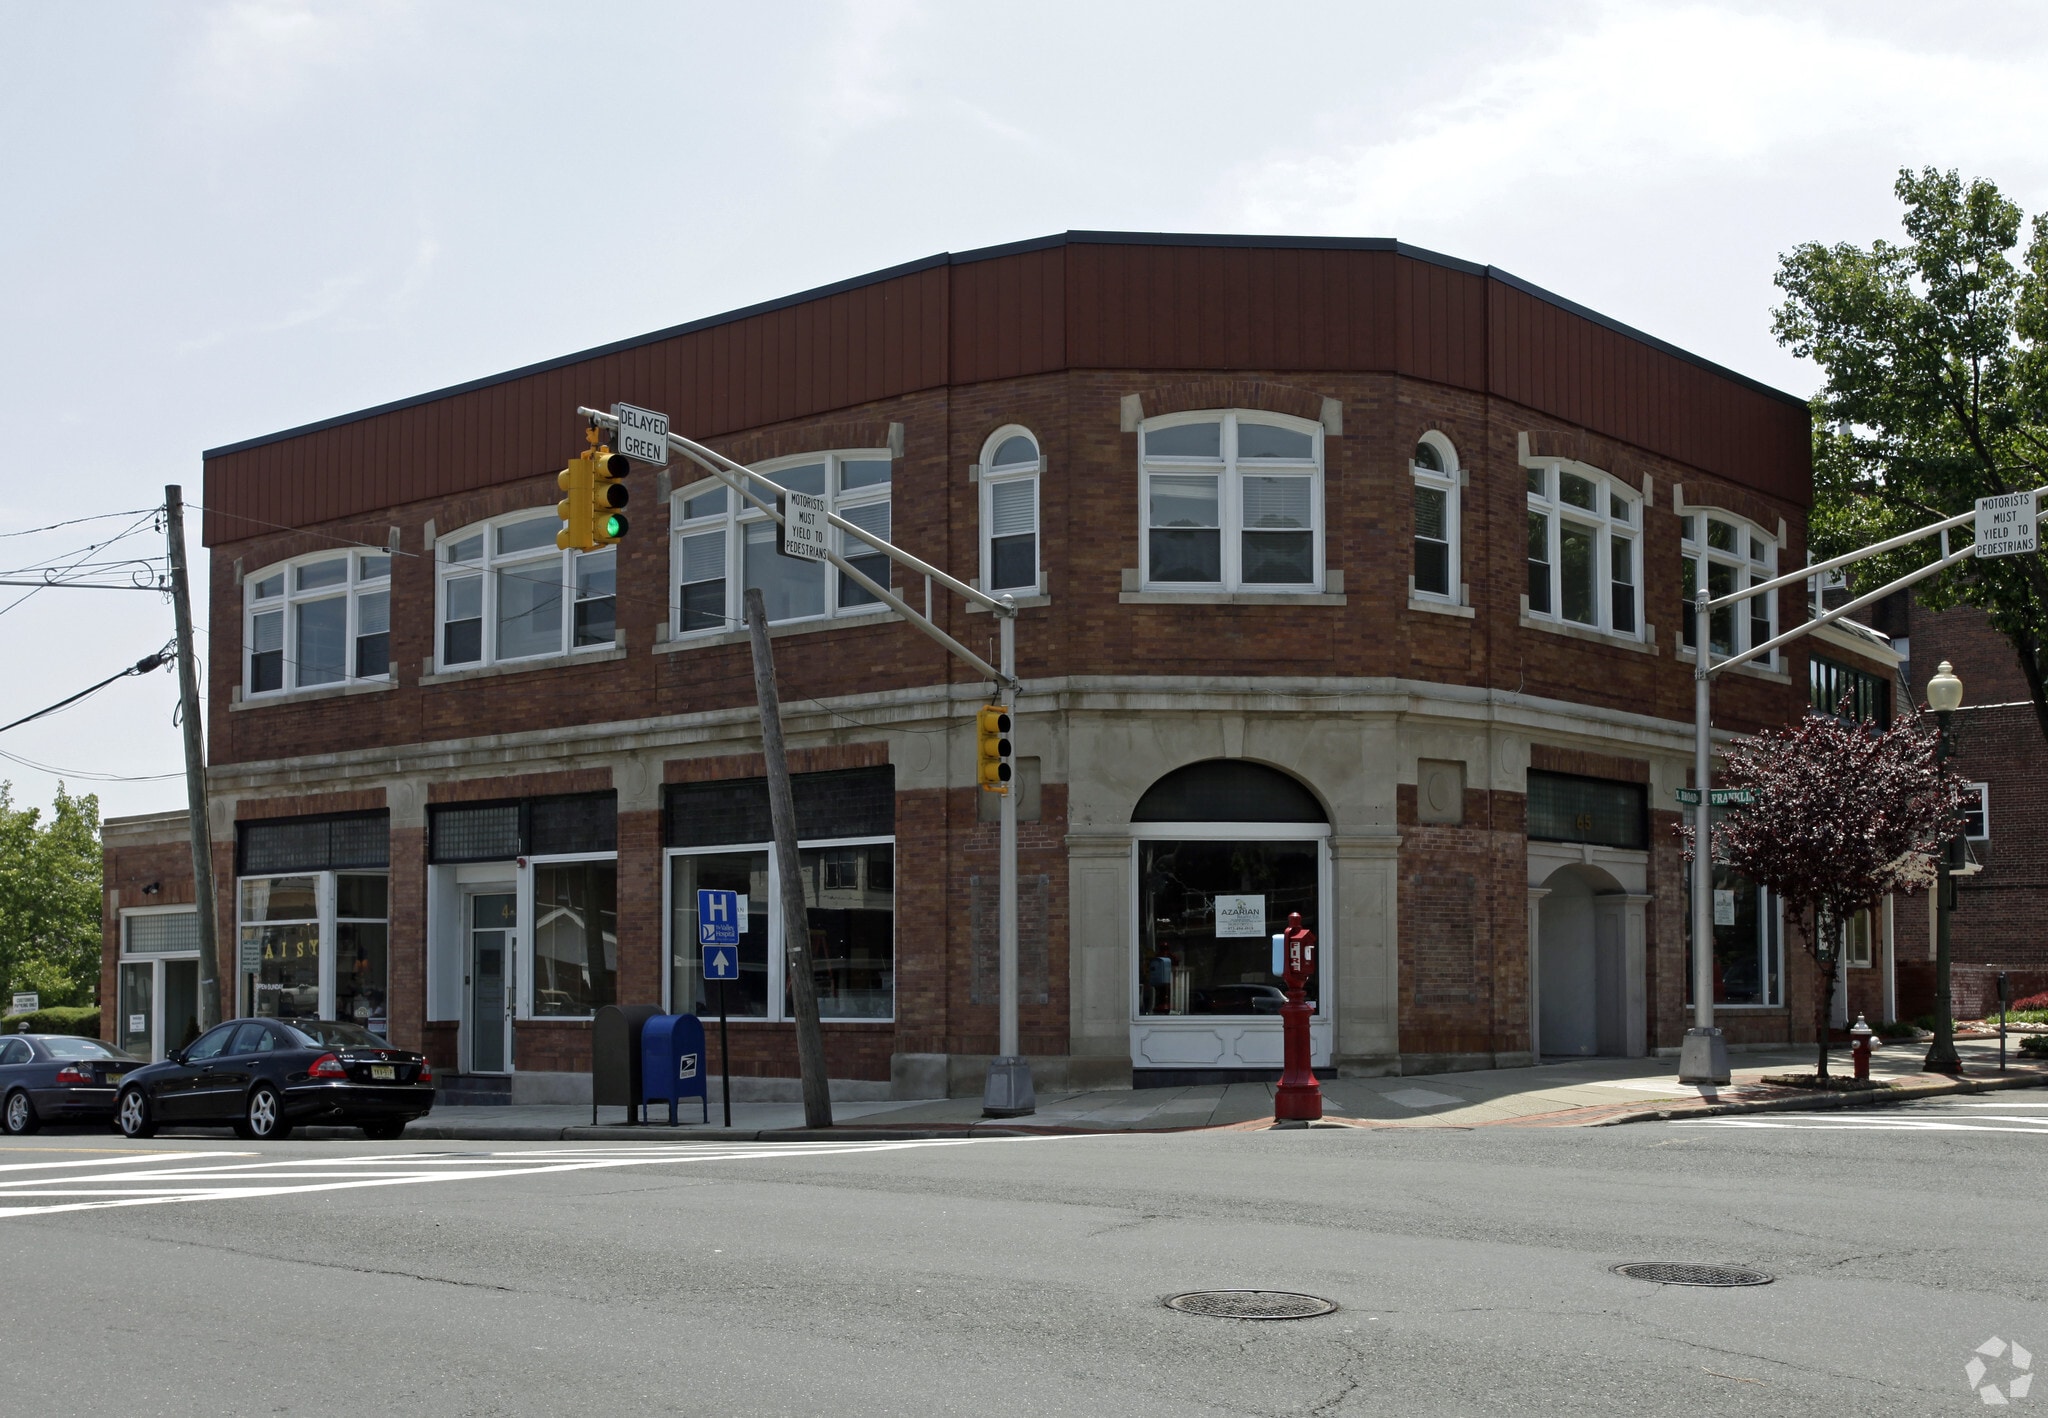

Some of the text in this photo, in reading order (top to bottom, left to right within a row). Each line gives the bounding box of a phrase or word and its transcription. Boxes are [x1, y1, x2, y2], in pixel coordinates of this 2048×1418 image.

[621, 409, 667, 435] DELAYED
[625, 436, 661, 461] GREEN
[791, 493, 824, 512] MOTORISTS
[1981, 494, 2030, 510] MOTORISTS
[798, 511, 815, 525] MUST
[1993, 511, 2017, 524] MUST
[792, 525, 823, 543] YIELD TO
[1983, 524, 2029, 540] YIELD TO
[785, 540, 827, 560] PEDESTRIANS
[1977, 538, 2034, 556] PEDESTRIANS
[708, 893, 728, 922] H
